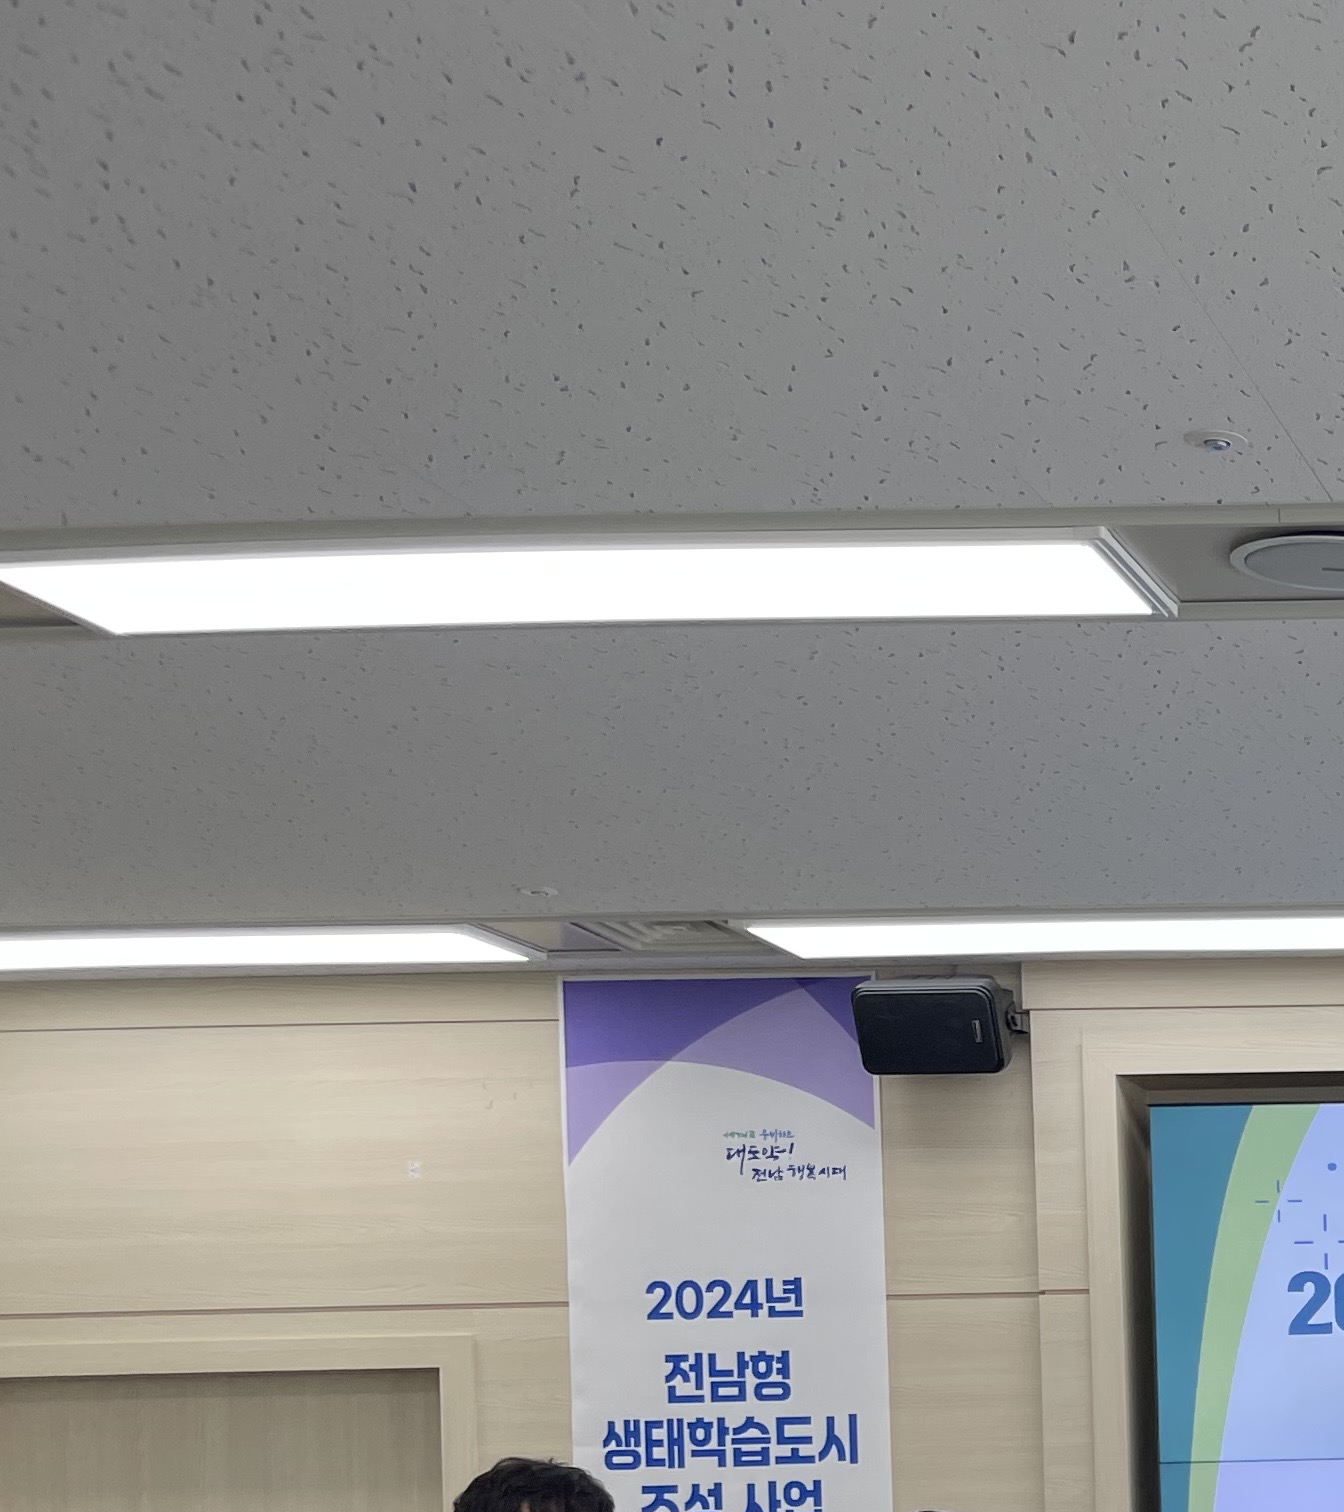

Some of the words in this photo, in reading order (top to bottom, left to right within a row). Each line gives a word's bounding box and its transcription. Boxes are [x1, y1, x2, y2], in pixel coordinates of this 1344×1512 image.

[646, 1277, 803, 1320] 2024년
[665, 1351, 791, 1403] 전남형
[603, 1414, 858, 1470] 생태학습도시
